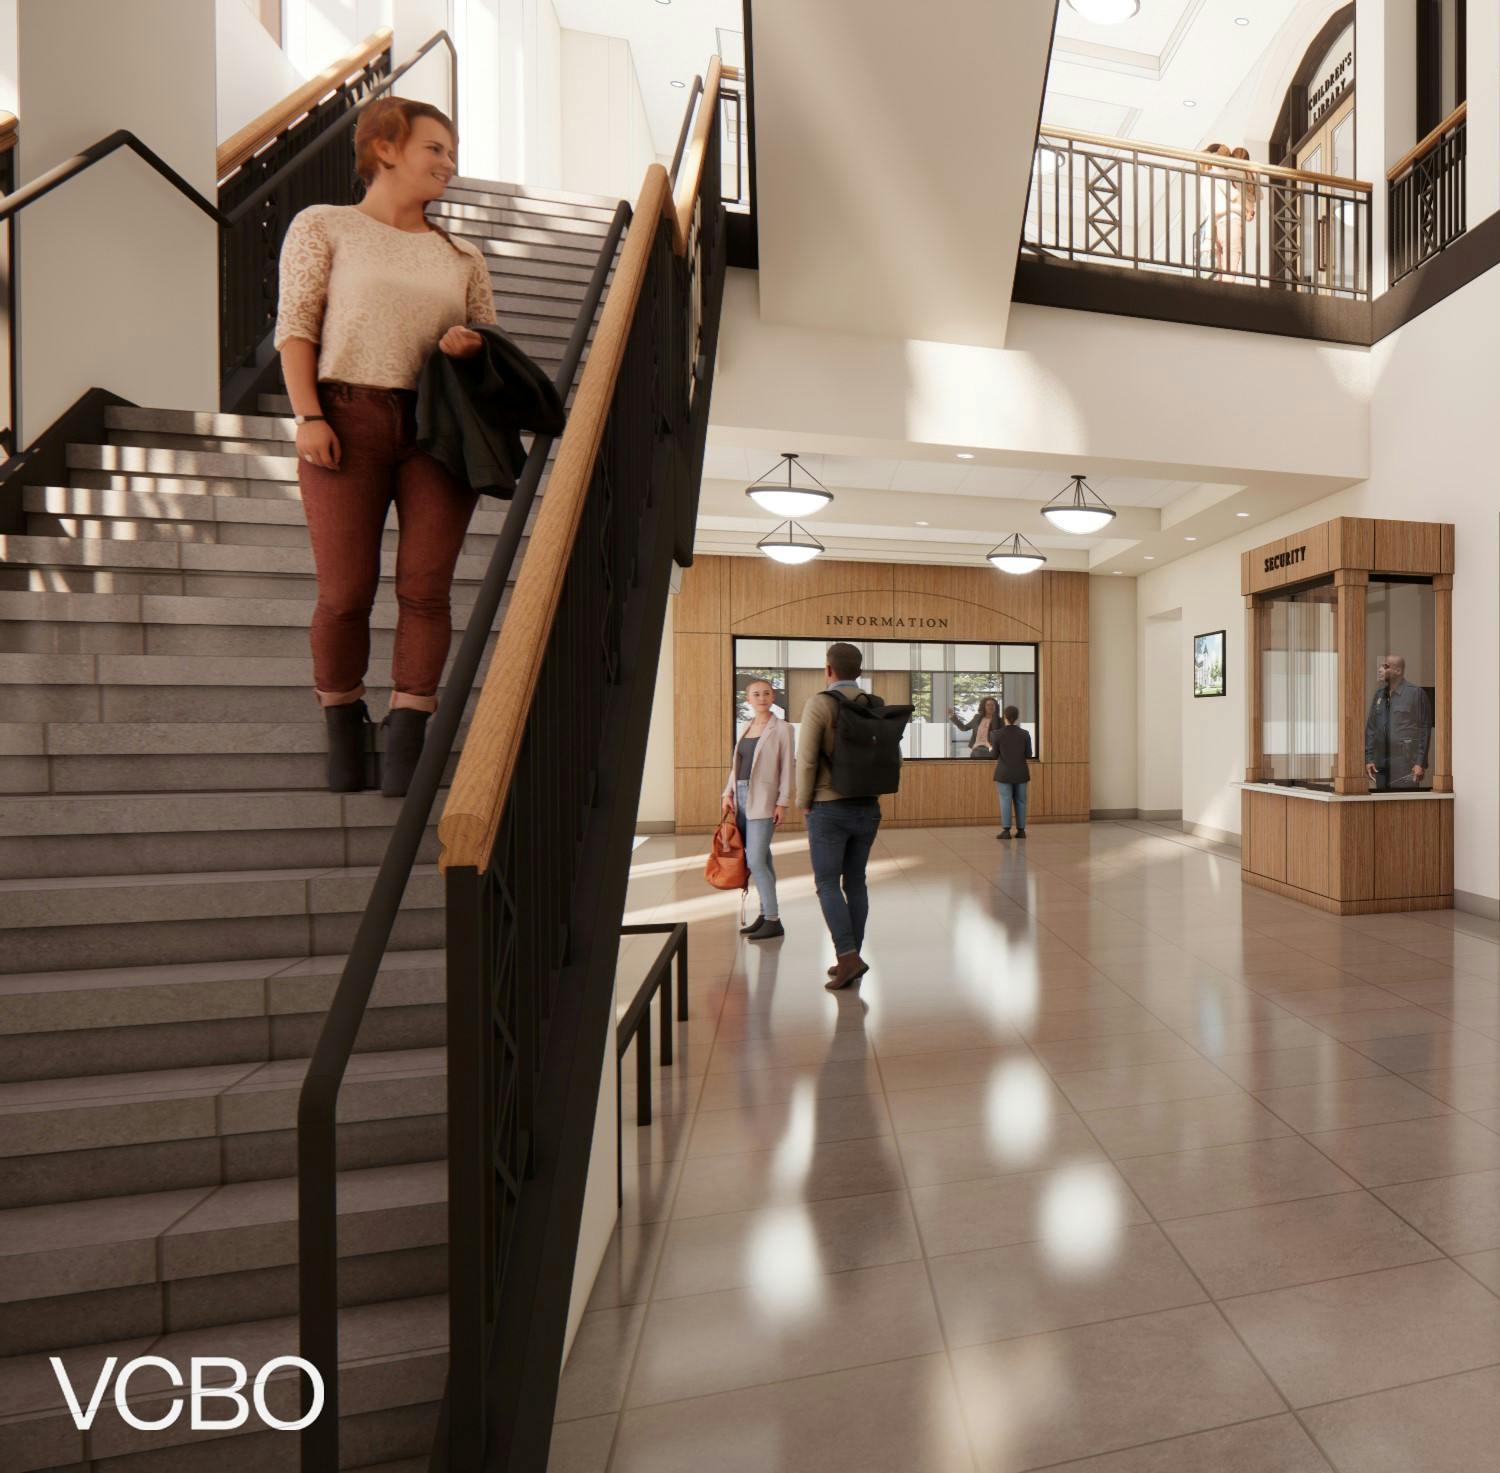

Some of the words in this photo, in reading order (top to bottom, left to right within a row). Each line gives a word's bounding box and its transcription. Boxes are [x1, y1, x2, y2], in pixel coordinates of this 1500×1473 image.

[1308, 52, 1352, 111] CHILDREN'S
[1313, 78, 1346, 123] LIBRARY
[1264, 545, 1306, 573] SECURITY
[826, 615, 949, 628] INFORMATION
